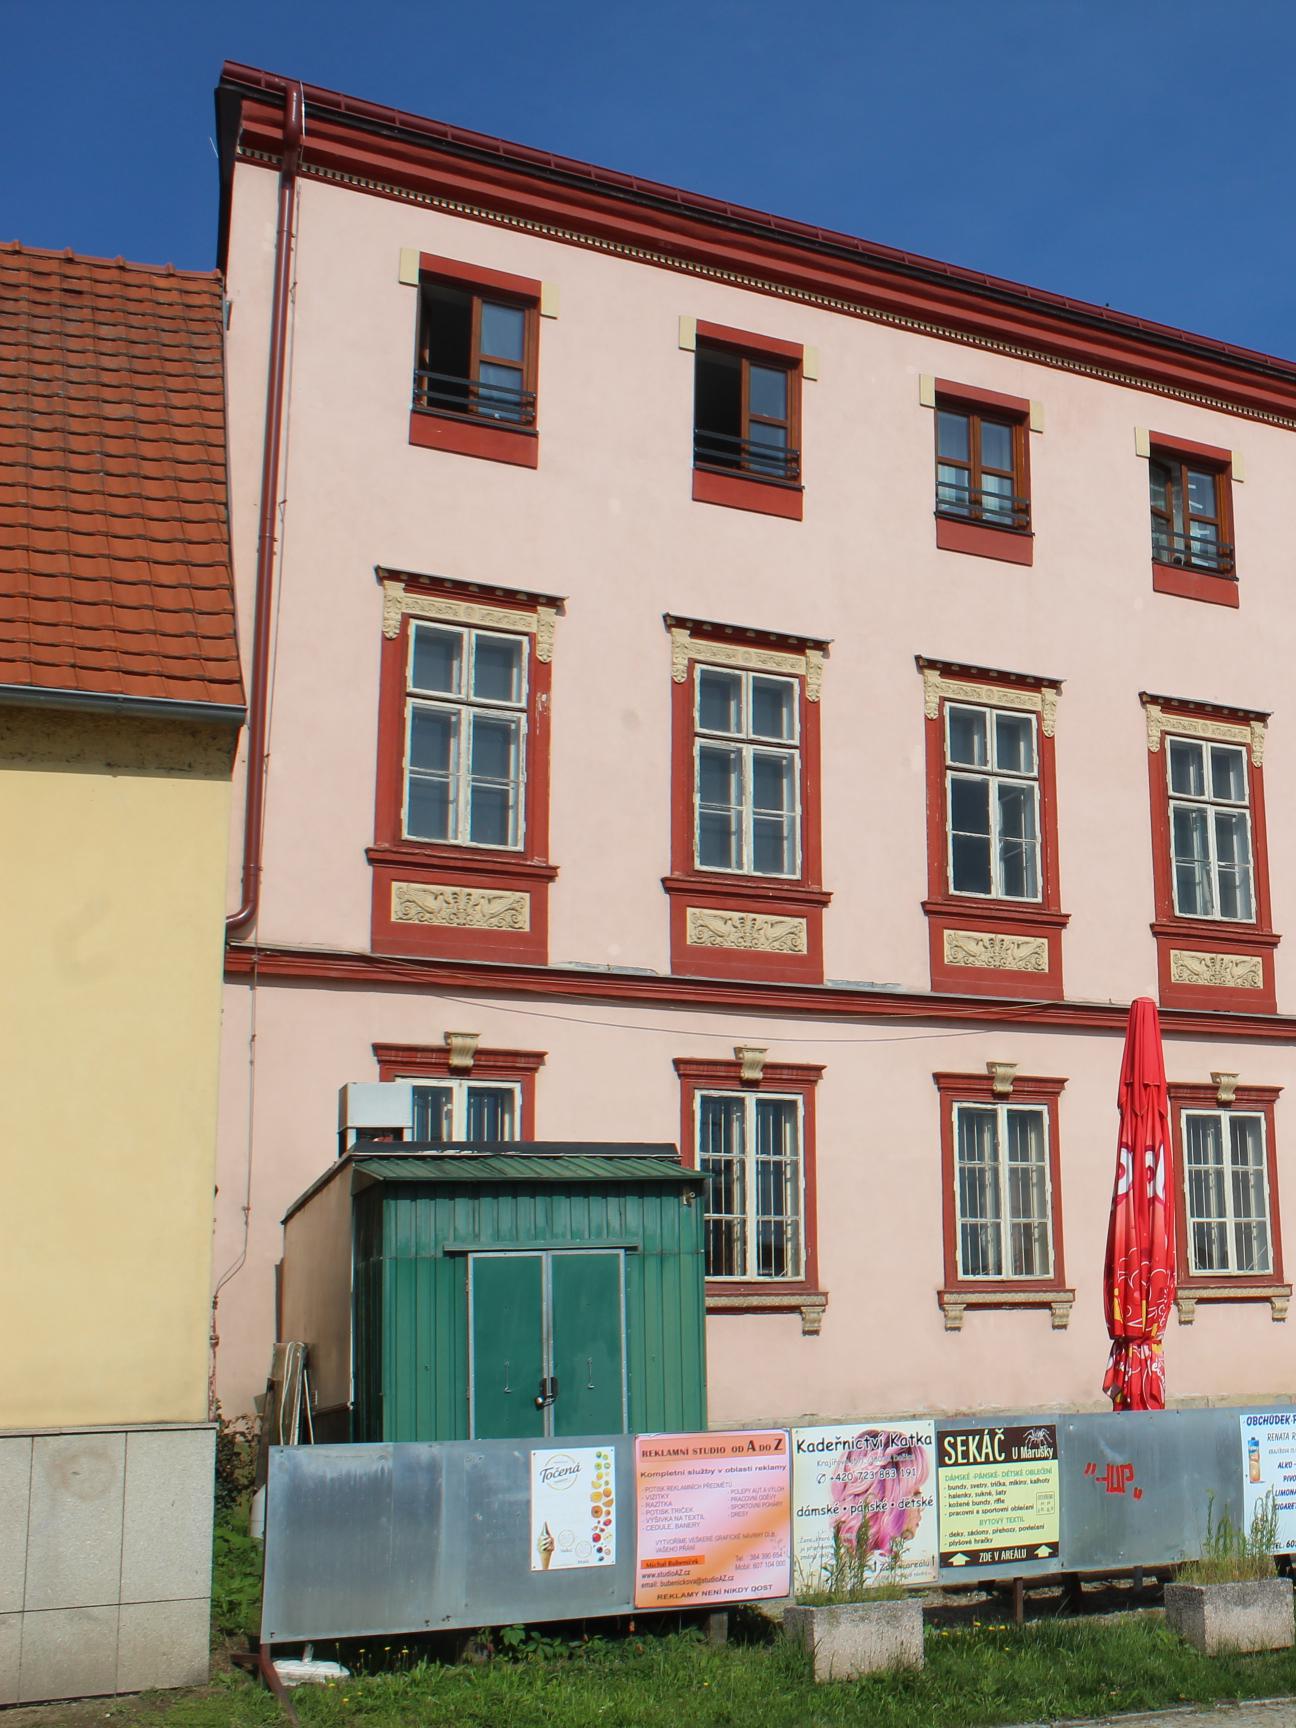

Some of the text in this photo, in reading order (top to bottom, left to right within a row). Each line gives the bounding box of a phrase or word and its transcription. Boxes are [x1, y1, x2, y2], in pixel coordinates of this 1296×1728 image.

[1247, 1415, 1290, 1426] OBCHŮDEK
[797, 1432, 933, 1453] Kadeřnictví Katka
[1267, 1432, 1289, 1441] RENATA
[642, 1448, 689, 1458] REKLAMNÍ
[692, 1446, 726, 1455] STUDIO
[747, 1440, 756, 1452] A
[774, 1438, 783, 1450] Z
[944, 1429, 1054, 1464] SEKÁČ U Marušky
[640, 1470, 685, 1478] Kompletní
[687, 1468, 715, 1476] služby
[755, 1464, 787, 1472] reklamy
[1278, 1461, 1293, 1469] ALKO
[540, 1463, 581, 1483] Točená
[830, 1468, 917, 1482] +420 723 883 191
[945, 1473, 970, 1481] DÁMSKÉ
[797, 1504, 839, 1517] dámské
[898, 1496, 934, 1509] dětské
[979, 1548, 1027, 1562] ZDE V AREÁLU
[657, 1592, 699, 1600] REKLAMY
[701, 1588, 722, 1596] NENÍ
[724, 1586, 749, 1594] NIKDY
